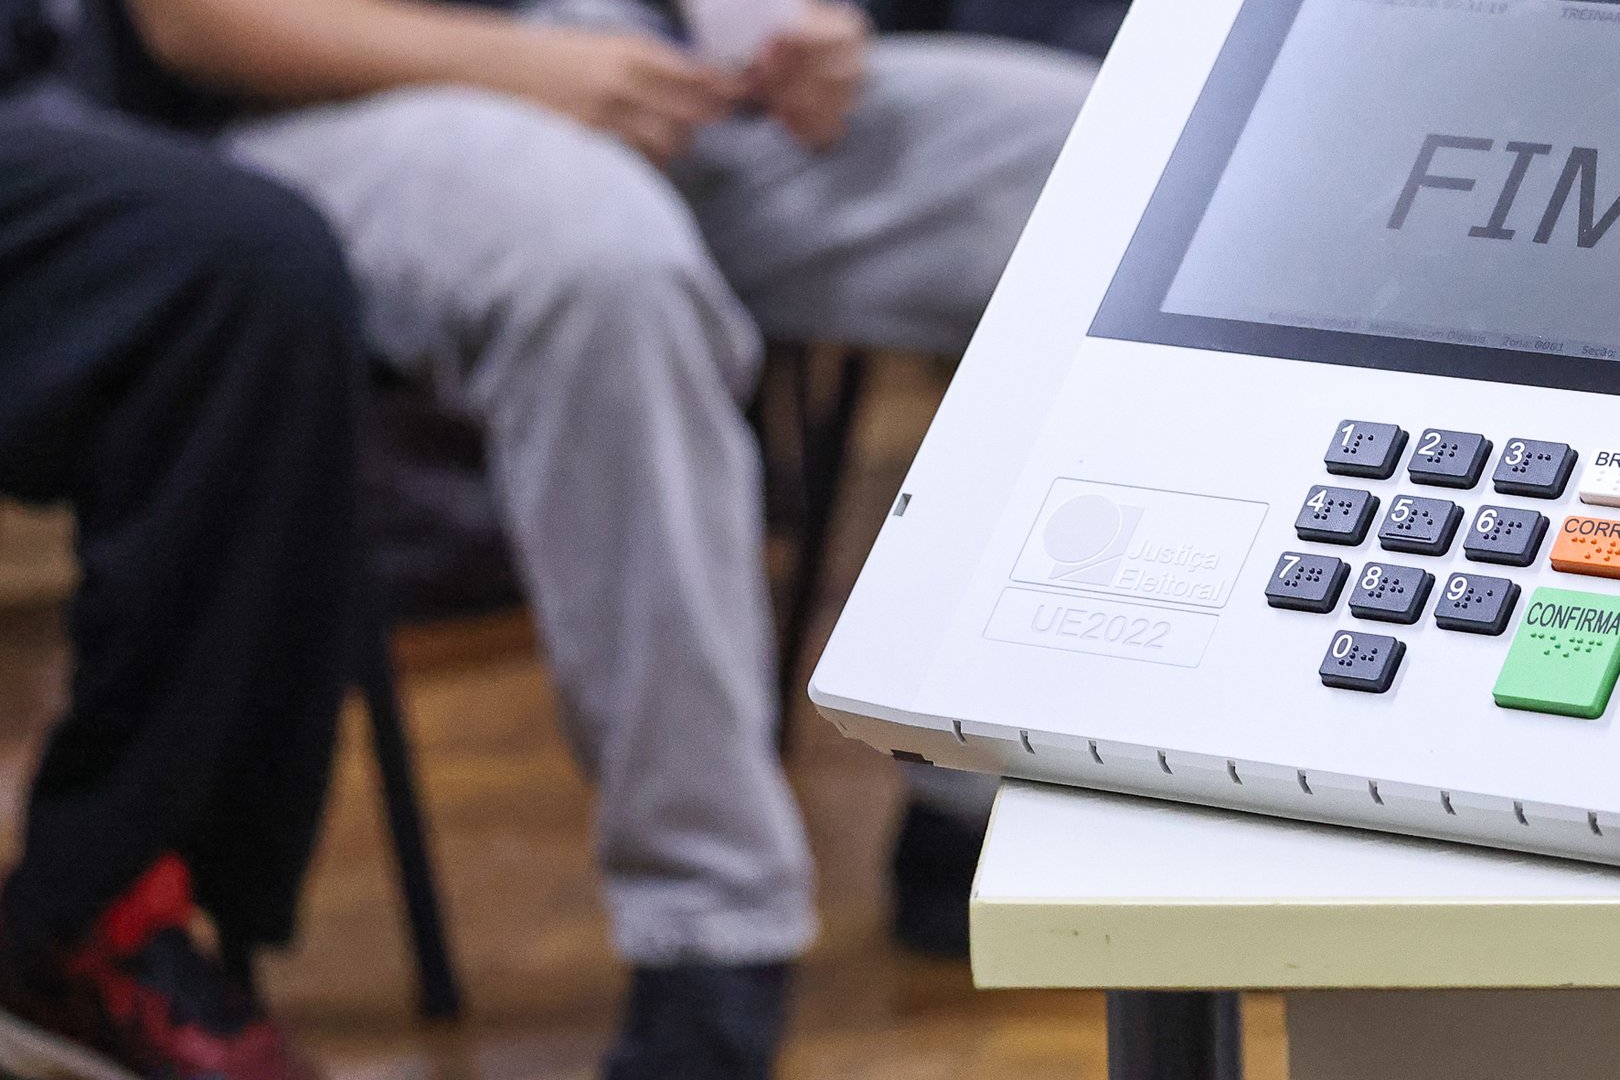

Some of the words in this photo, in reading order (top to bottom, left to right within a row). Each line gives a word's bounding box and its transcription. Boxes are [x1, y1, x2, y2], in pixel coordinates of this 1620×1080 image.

[1534, 339, 1564, 351] 0001
[1581, 344, 1617, 360] Seção:
[1341, 424, 1355, 446] 1
[1418, 432, 1441, 455] 2
[1505, 442, 1525, 465] 3
[1307, 489, 1327, 512] 4
[1391, 499, 1413, 522] 5
[1475, 509, 1498, 532] 6
[1127, 538, 1221, 573] Justiça
[1278, 555, 1300, 578] 7
[1115, 568, 1226, 601] Eleitoral
[1361, 566, 1382, 590] 8
[1446, 576, 1467, 600] 9
[1030, 603, 1172, 649] UE2022
[1332, 634, 1353, 658] 0
